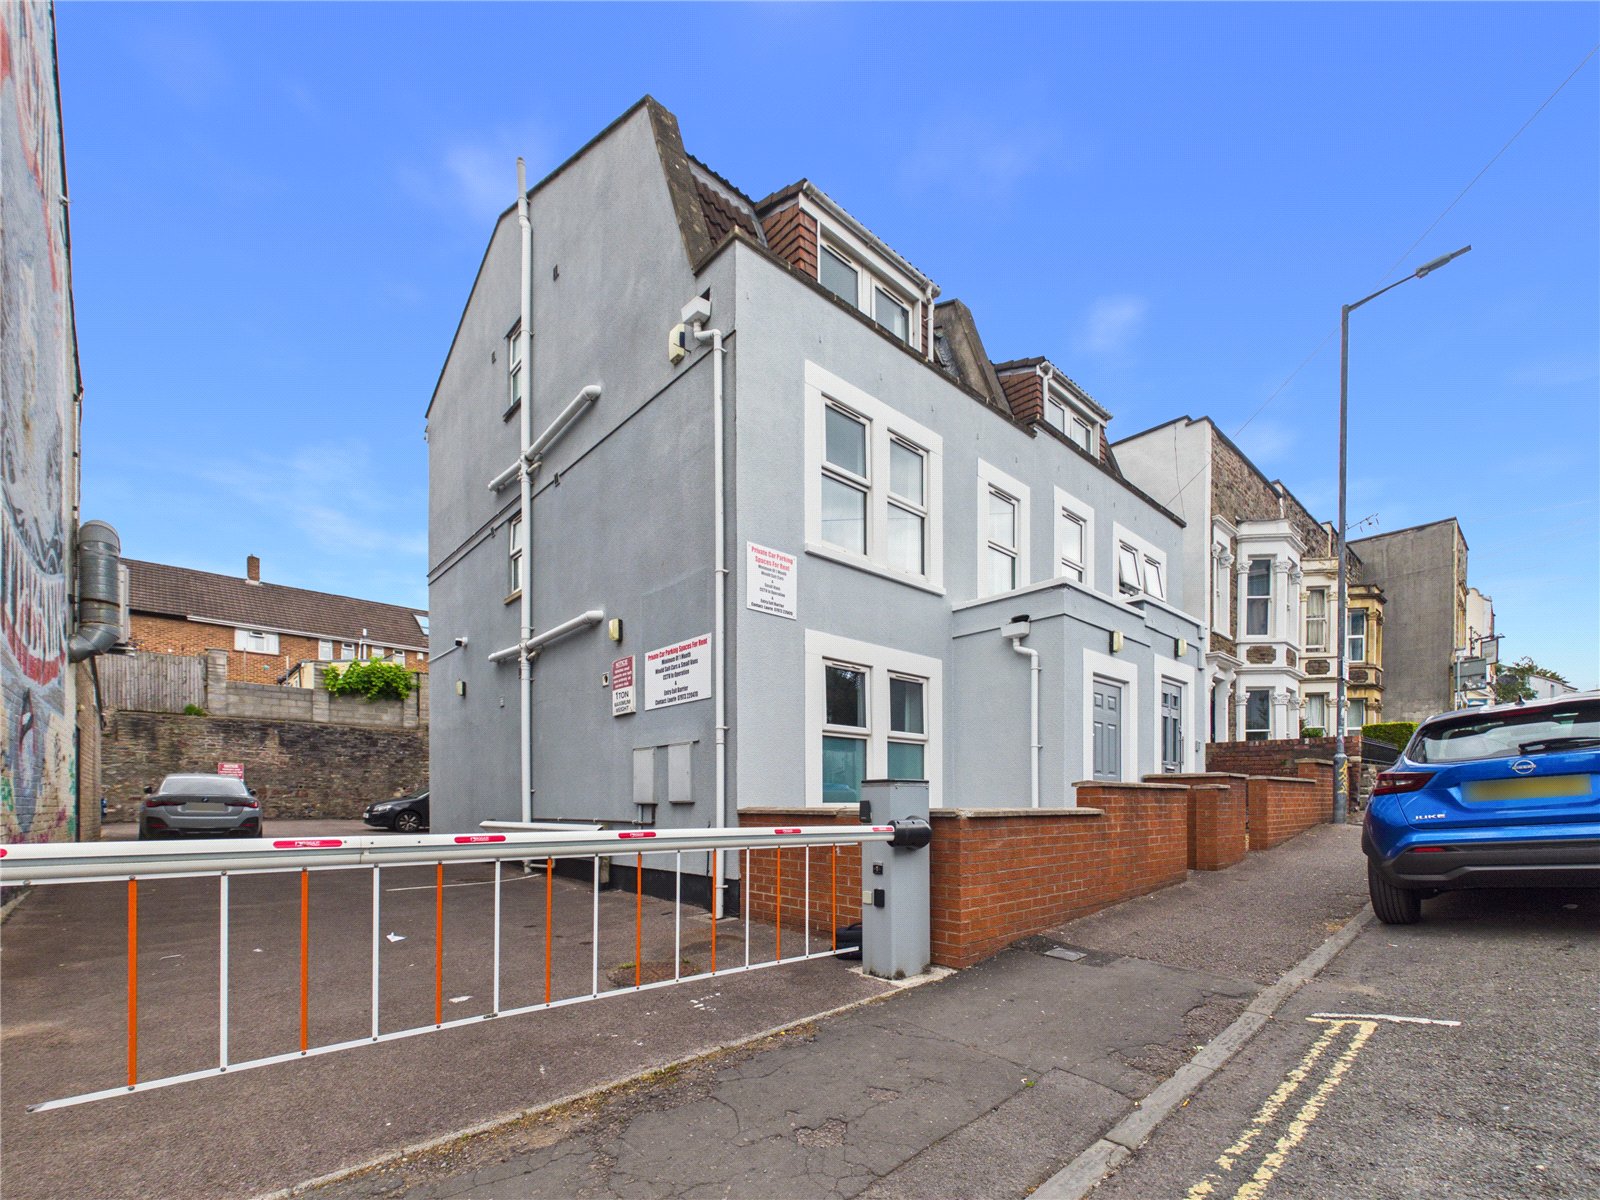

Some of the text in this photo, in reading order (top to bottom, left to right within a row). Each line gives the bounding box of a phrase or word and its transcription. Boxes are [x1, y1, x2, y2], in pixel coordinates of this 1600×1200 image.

[752, 546, 767, 556] Private
[777, 554, 793, 565] Parking
[755, 556, 771, 566] Spaces
[679, 643, 691, 652] Spaces
[699, 638, 707, 646] Rent
